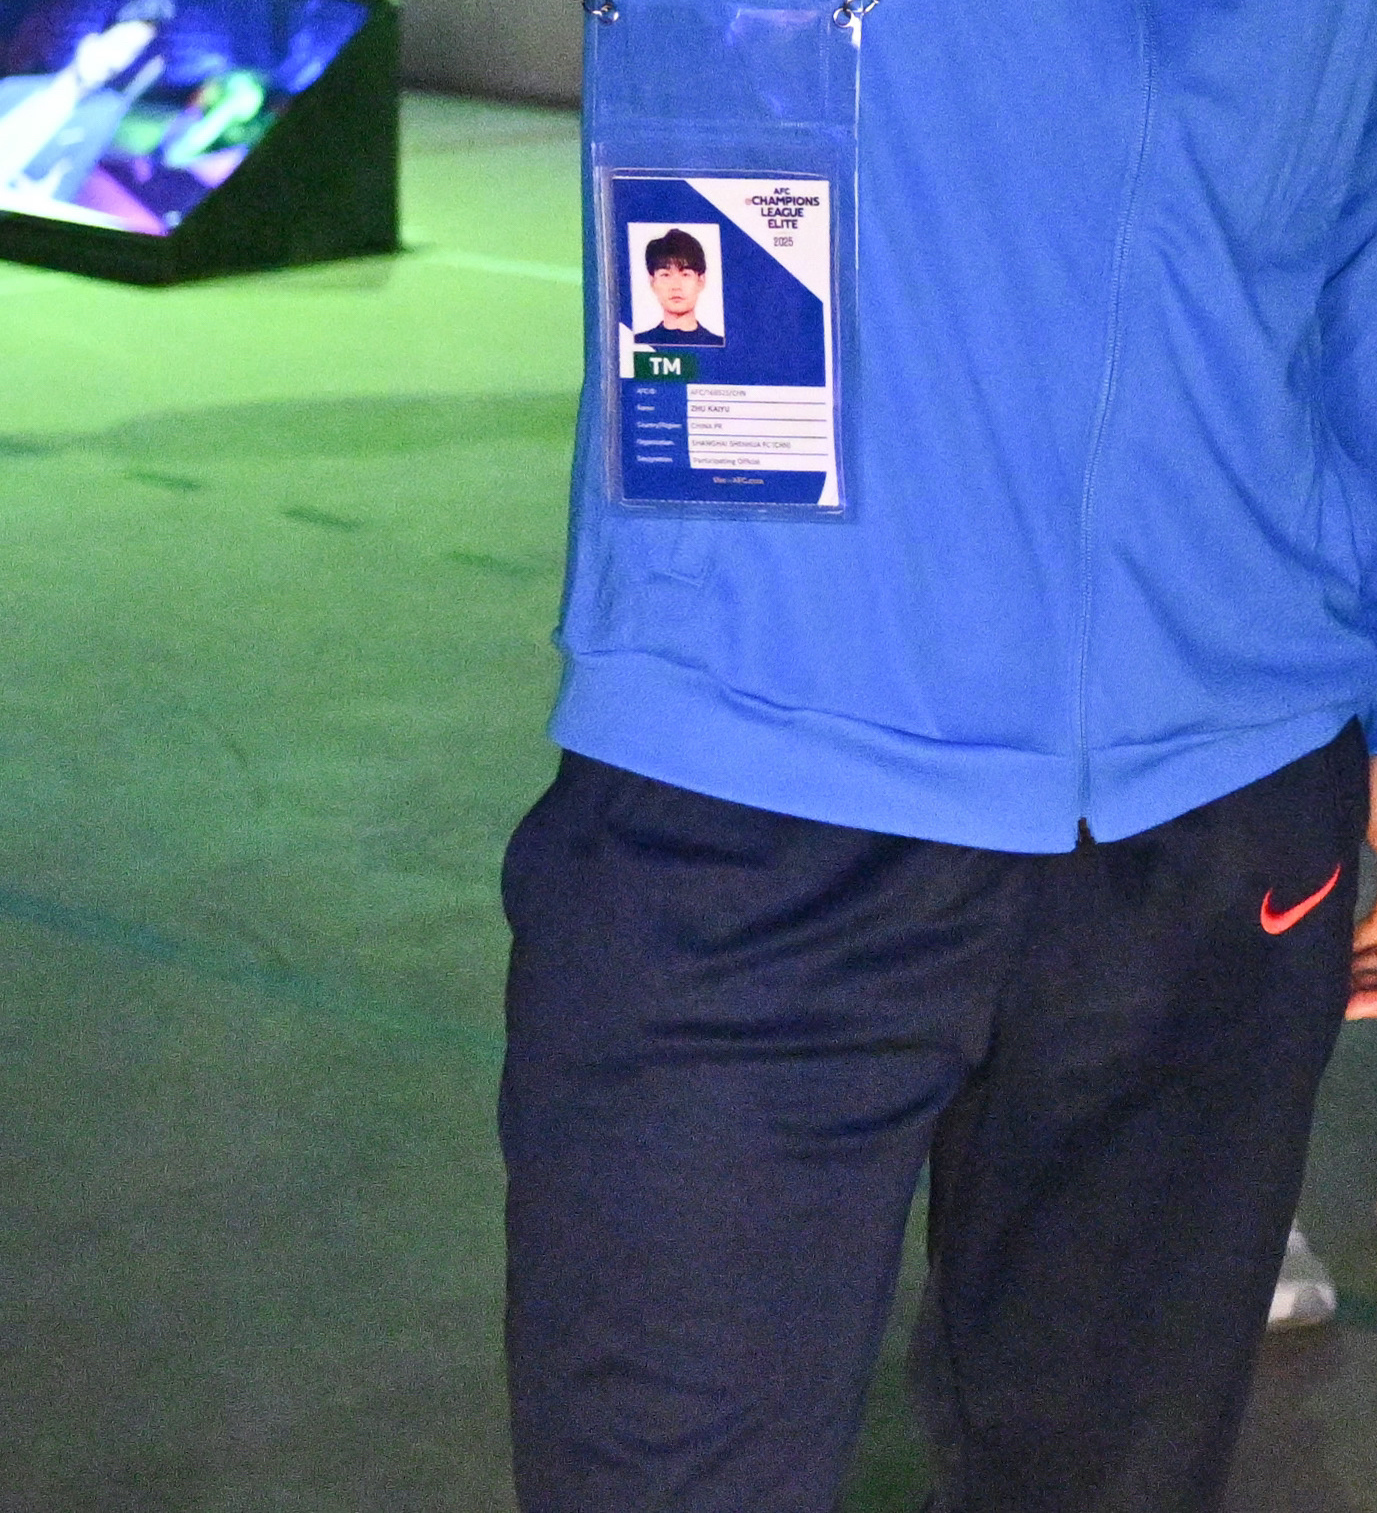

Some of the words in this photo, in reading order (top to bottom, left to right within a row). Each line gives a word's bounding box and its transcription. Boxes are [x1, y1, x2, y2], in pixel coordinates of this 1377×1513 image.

[773, 187, 791, 195] AFC
[760, 207, 804, 217] LEAGUE
[767, 219, 798, 229] ELITE
[773, 236, 794, 247] 2025
[649, 357, 682, 376] TM
[690, 405, 706, 413] ZHU
[707, 405, 730, 413] KAIYU
